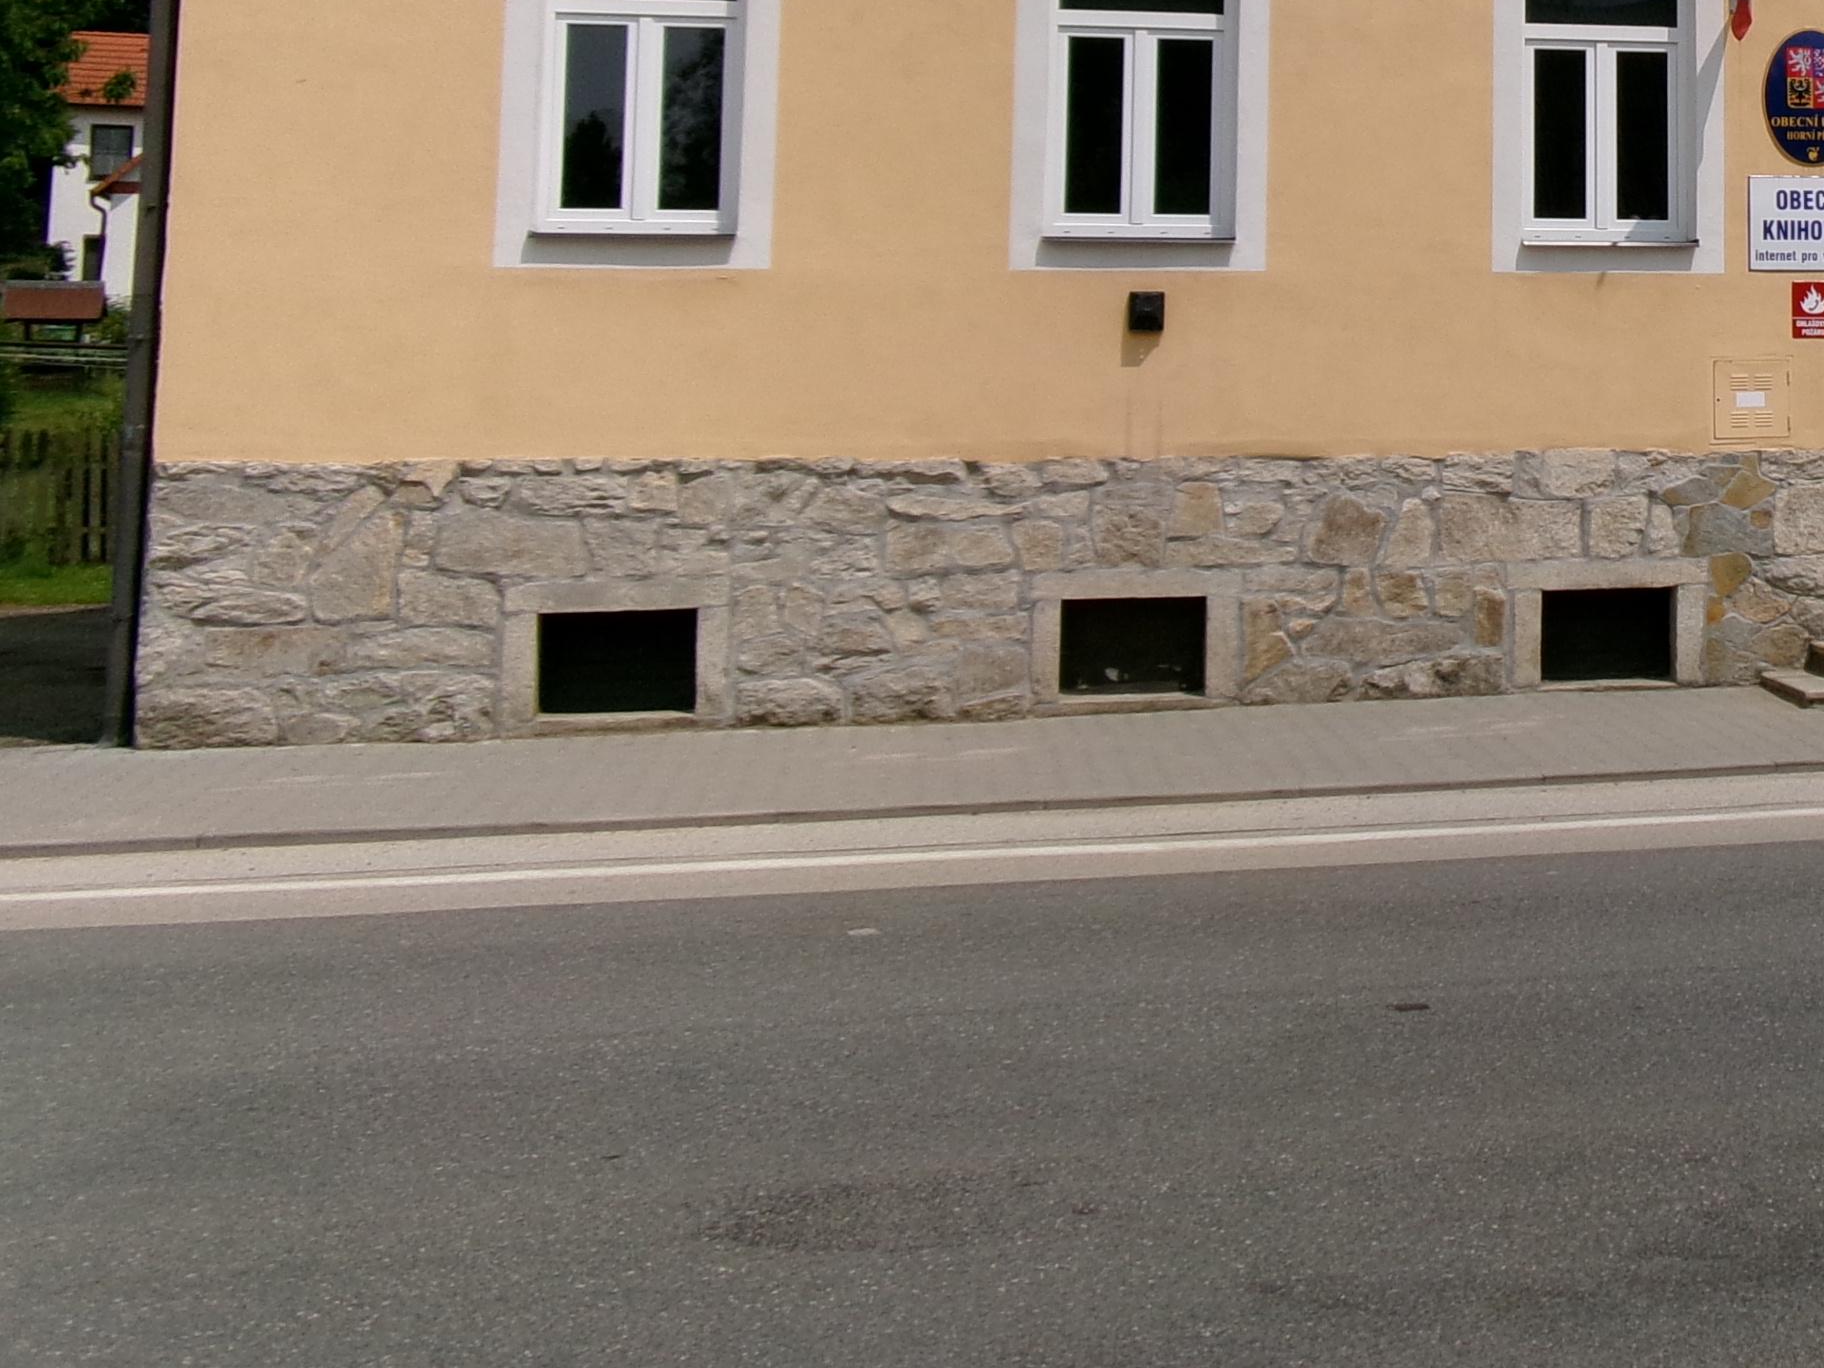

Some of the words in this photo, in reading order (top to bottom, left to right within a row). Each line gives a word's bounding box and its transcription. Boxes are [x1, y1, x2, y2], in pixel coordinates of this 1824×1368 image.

[1771, 114, 1818, 128] OBECNÍ
[1786, 129, 1815, 141] HORNÍ
[1755, 250, 1797, 261] internet
[1801, 252, 1818, 264] pro
